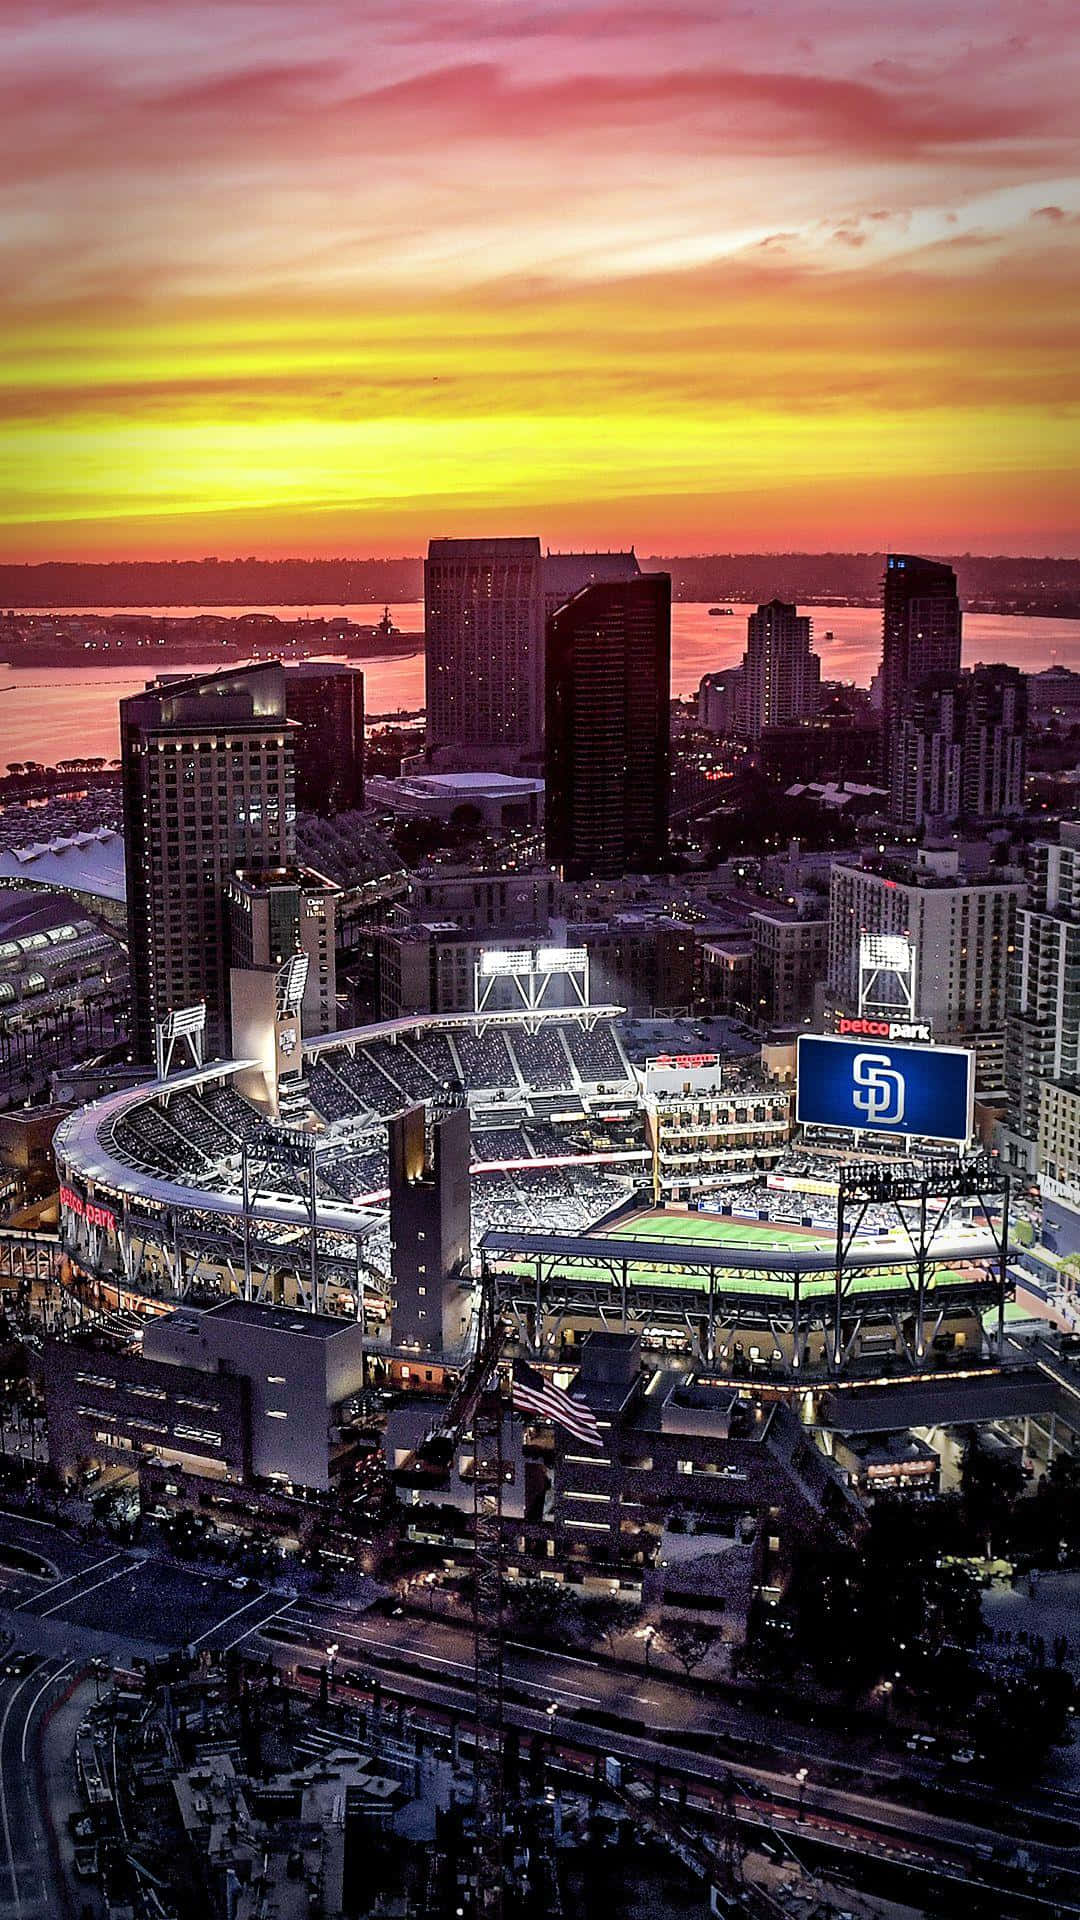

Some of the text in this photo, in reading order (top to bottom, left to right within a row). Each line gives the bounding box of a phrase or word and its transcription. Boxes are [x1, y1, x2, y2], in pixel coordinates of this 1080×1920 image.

[658, 1104, 700, 1115] WESTERN
[703, 1101, 734, 1111] METAL
[735, 1098, 770, 1109] SUPPLY
